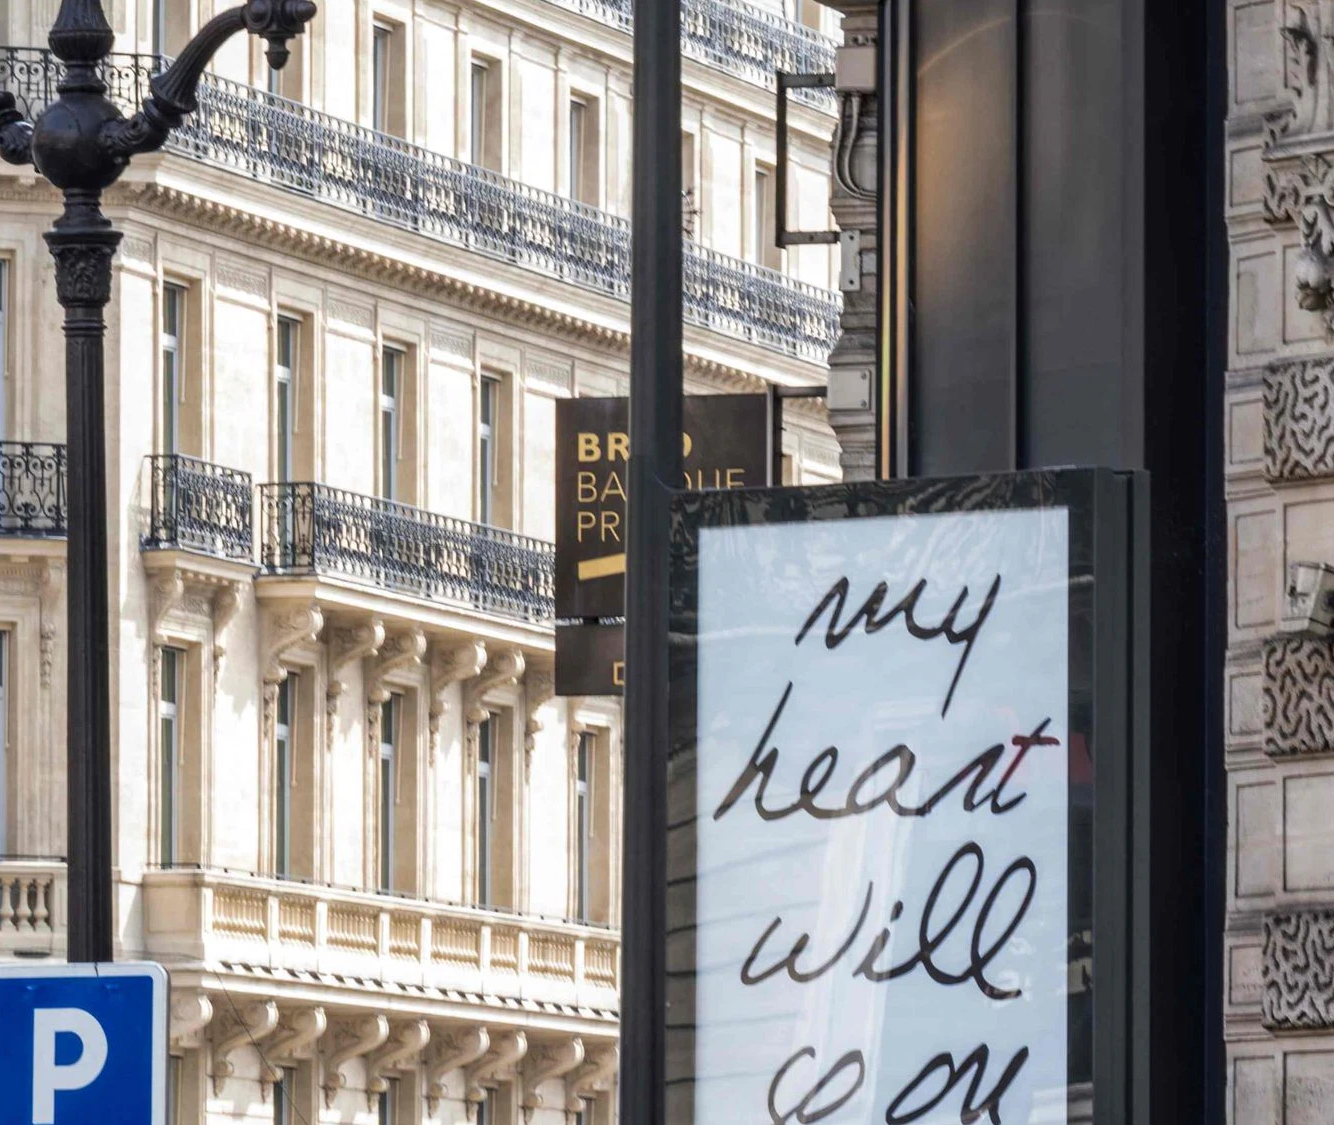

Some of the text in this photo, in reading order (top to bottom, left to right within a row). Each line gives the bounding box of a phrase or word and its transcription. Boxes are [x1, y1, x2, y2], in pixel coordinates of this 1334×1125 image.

[795, 573, 1004, 718] my
[713, 680, 1061, 822] heart
[740, 841, 1038, 1002] will
[32, 1007, 108, 1125] P
